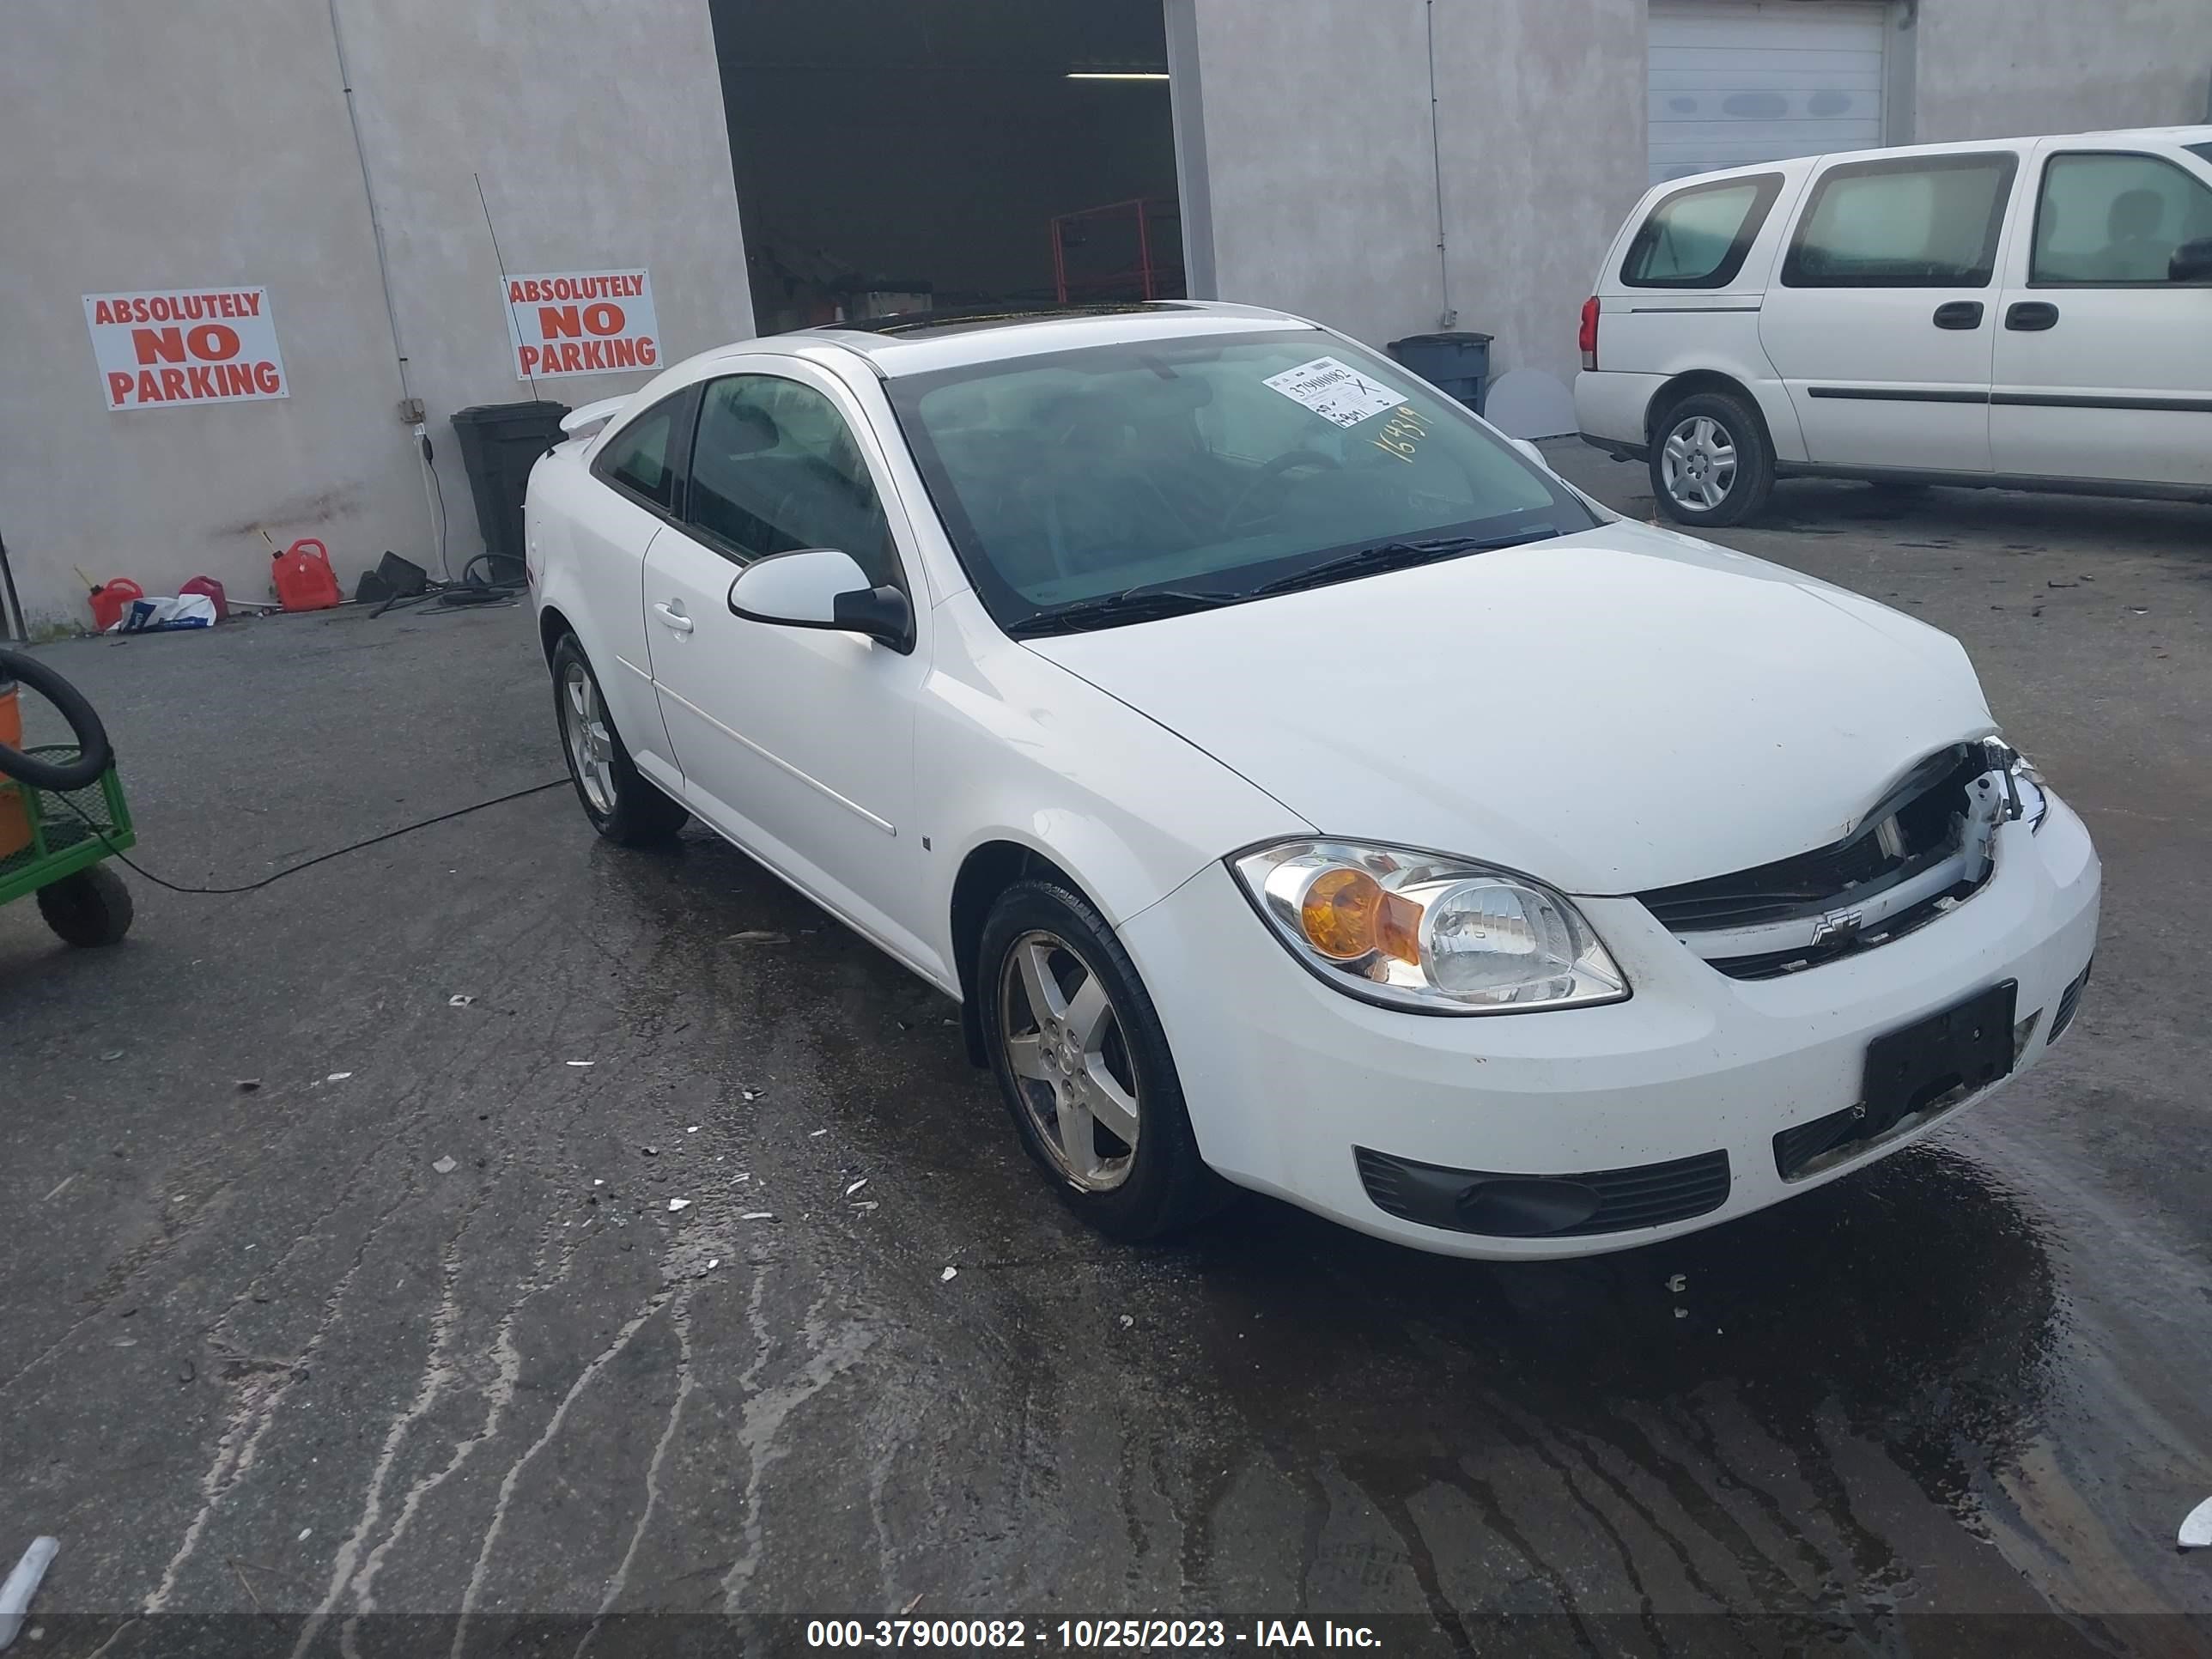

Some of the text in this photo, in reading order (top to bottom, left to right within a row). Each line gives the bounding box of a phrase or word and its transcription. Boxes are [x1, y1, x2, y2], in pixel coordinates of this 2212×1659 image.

[509, 275, 643, 303] ABSOLUTELY
[95, 292, 261, 325] ABSOLUTELY
[538, 302, 626, 340] NO
[131, 325, 240, 364] NO
[518, 337, 656, 374] PARKING
[107, 362, 280, 404] PARKING
[1289, 368, 1352, 398] 37900082
